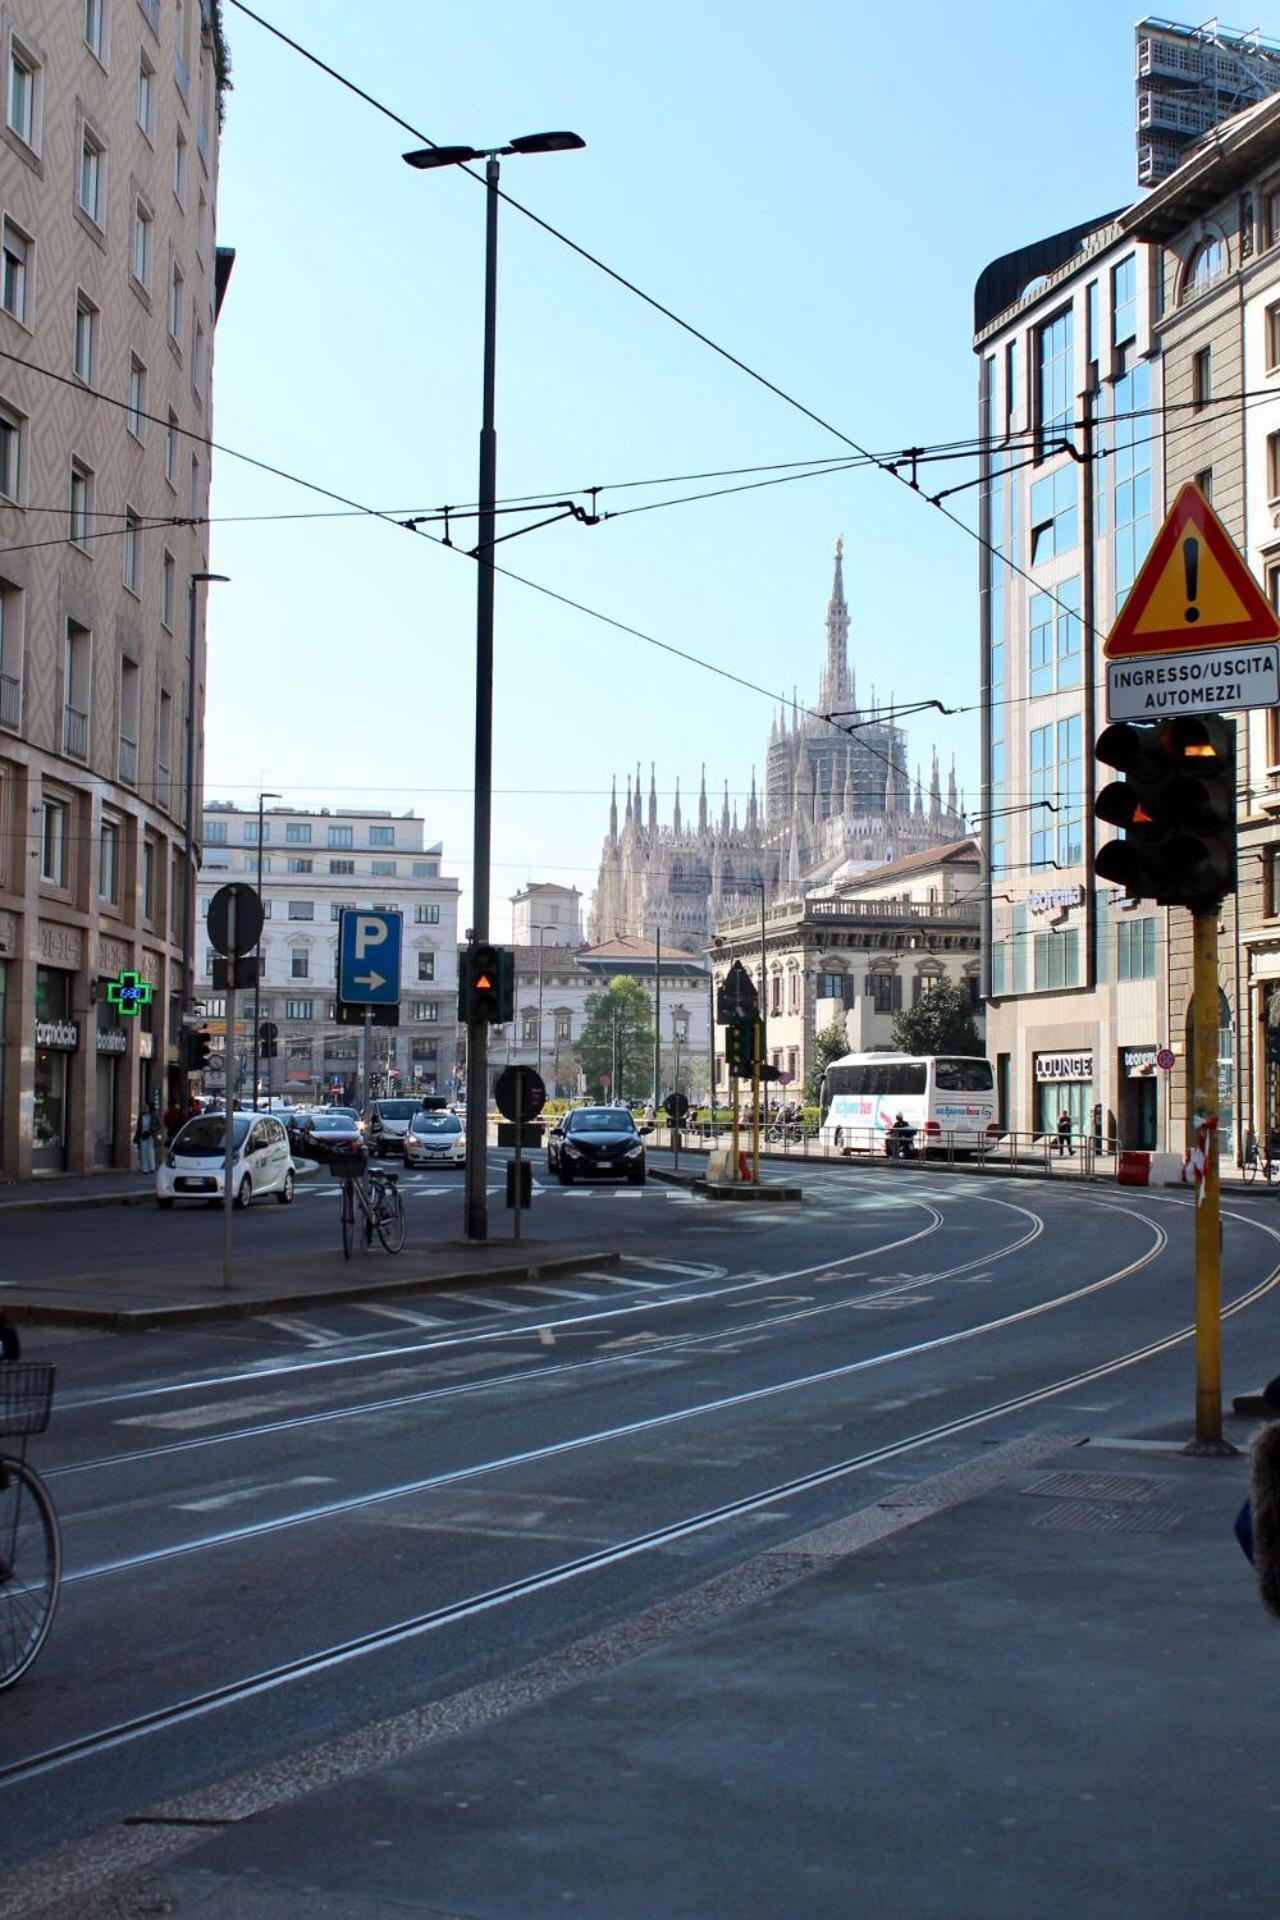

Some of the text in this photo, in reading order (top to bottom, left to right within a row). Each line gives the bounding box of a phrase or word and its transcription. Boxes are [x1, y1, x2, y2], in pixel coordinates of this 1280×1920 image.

[1114, 656, 1273, 688] INGRESSO/USCITA
[1144, 684, 1241, 708] AUTOMEZZI
[355, 916, 388, 959] P
[1036, 1055, 1092, 1077] LOUNGE
